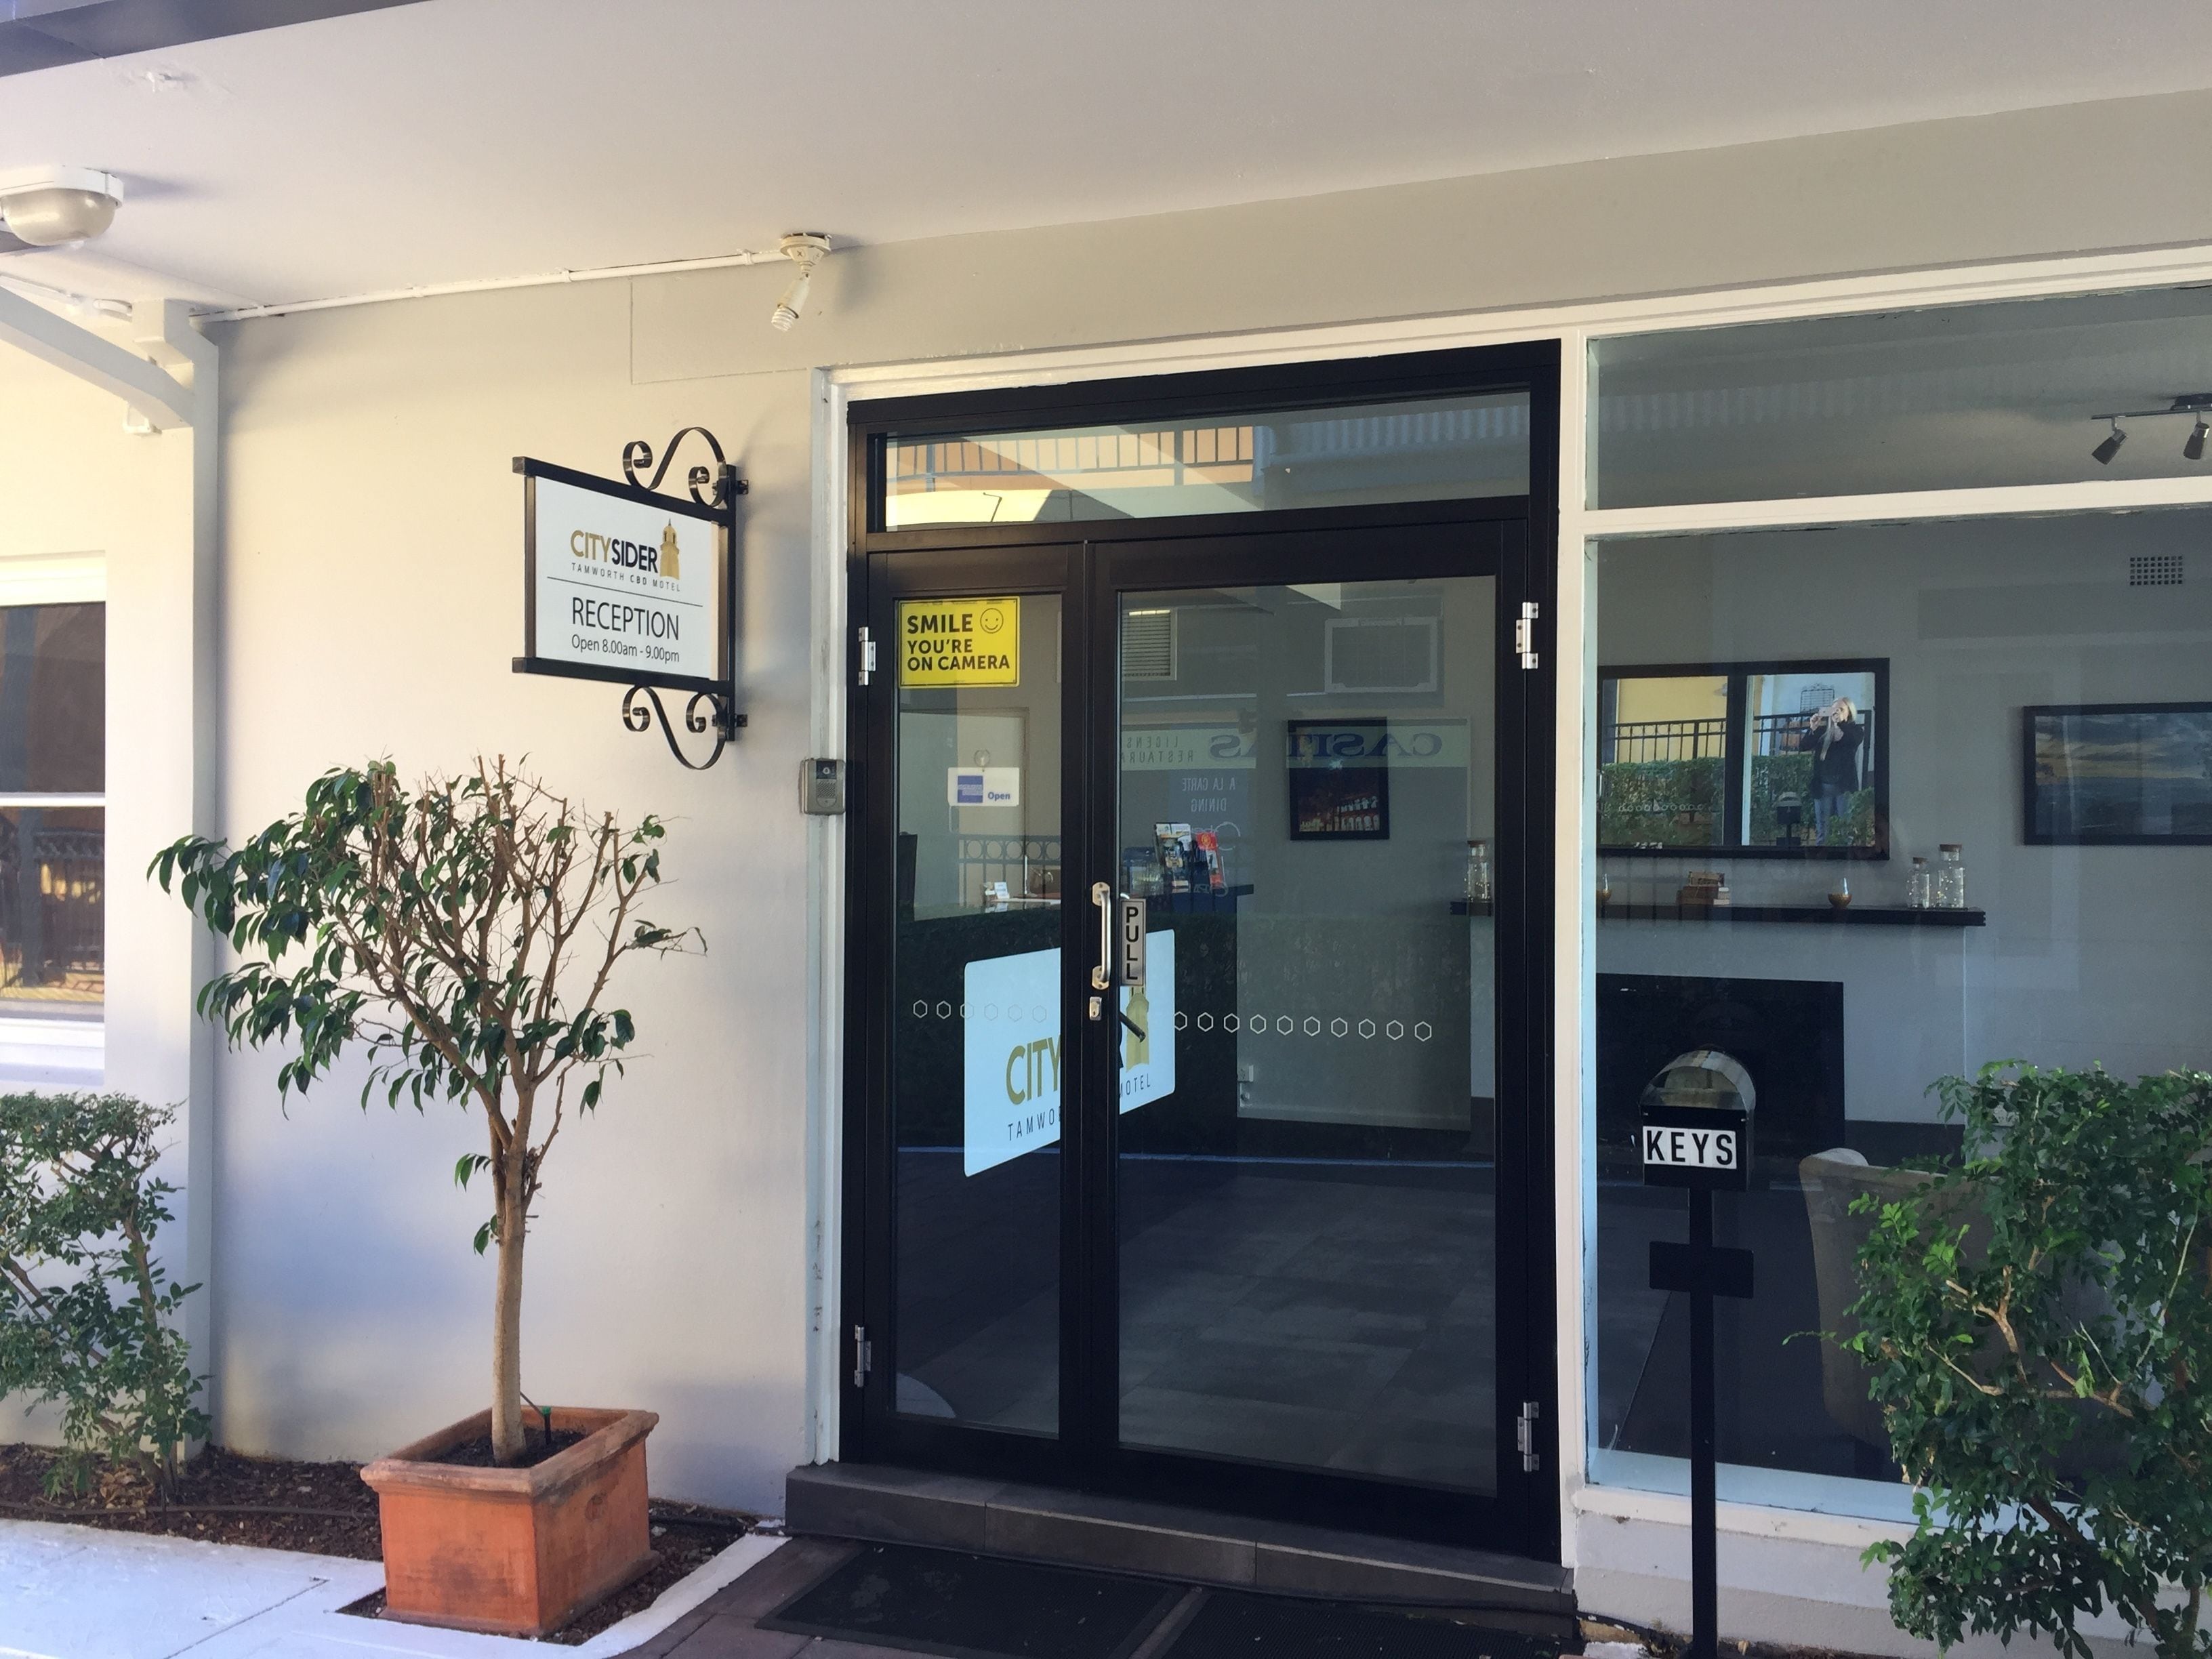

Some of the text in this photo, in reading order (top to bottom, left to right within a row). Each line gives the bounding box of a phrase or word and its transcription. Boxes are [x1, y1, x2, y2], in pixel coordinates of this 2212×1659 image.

[572, 562, 680, 592] TAMWORTH CBD MOTEL
[573, 597, 678, 640] RECEPTION
[907, 613, 973, 634] SMILE
[572, 634, 599, 653] Open
[602, 638, 638, 657] 8.00am
[646, 645, 680, 665] 9.00pm
[907, 638, 973, 655] YOU'RE
[907, 655, 1010, 671] ON CAMERA
[987, 792, 1010, 801] Open
[1126, 906, 1139, 981] PULL
[1008, 1106, 1061, 1141] TAMWO
[1647, 1130, 1733, 1166] KEYS
